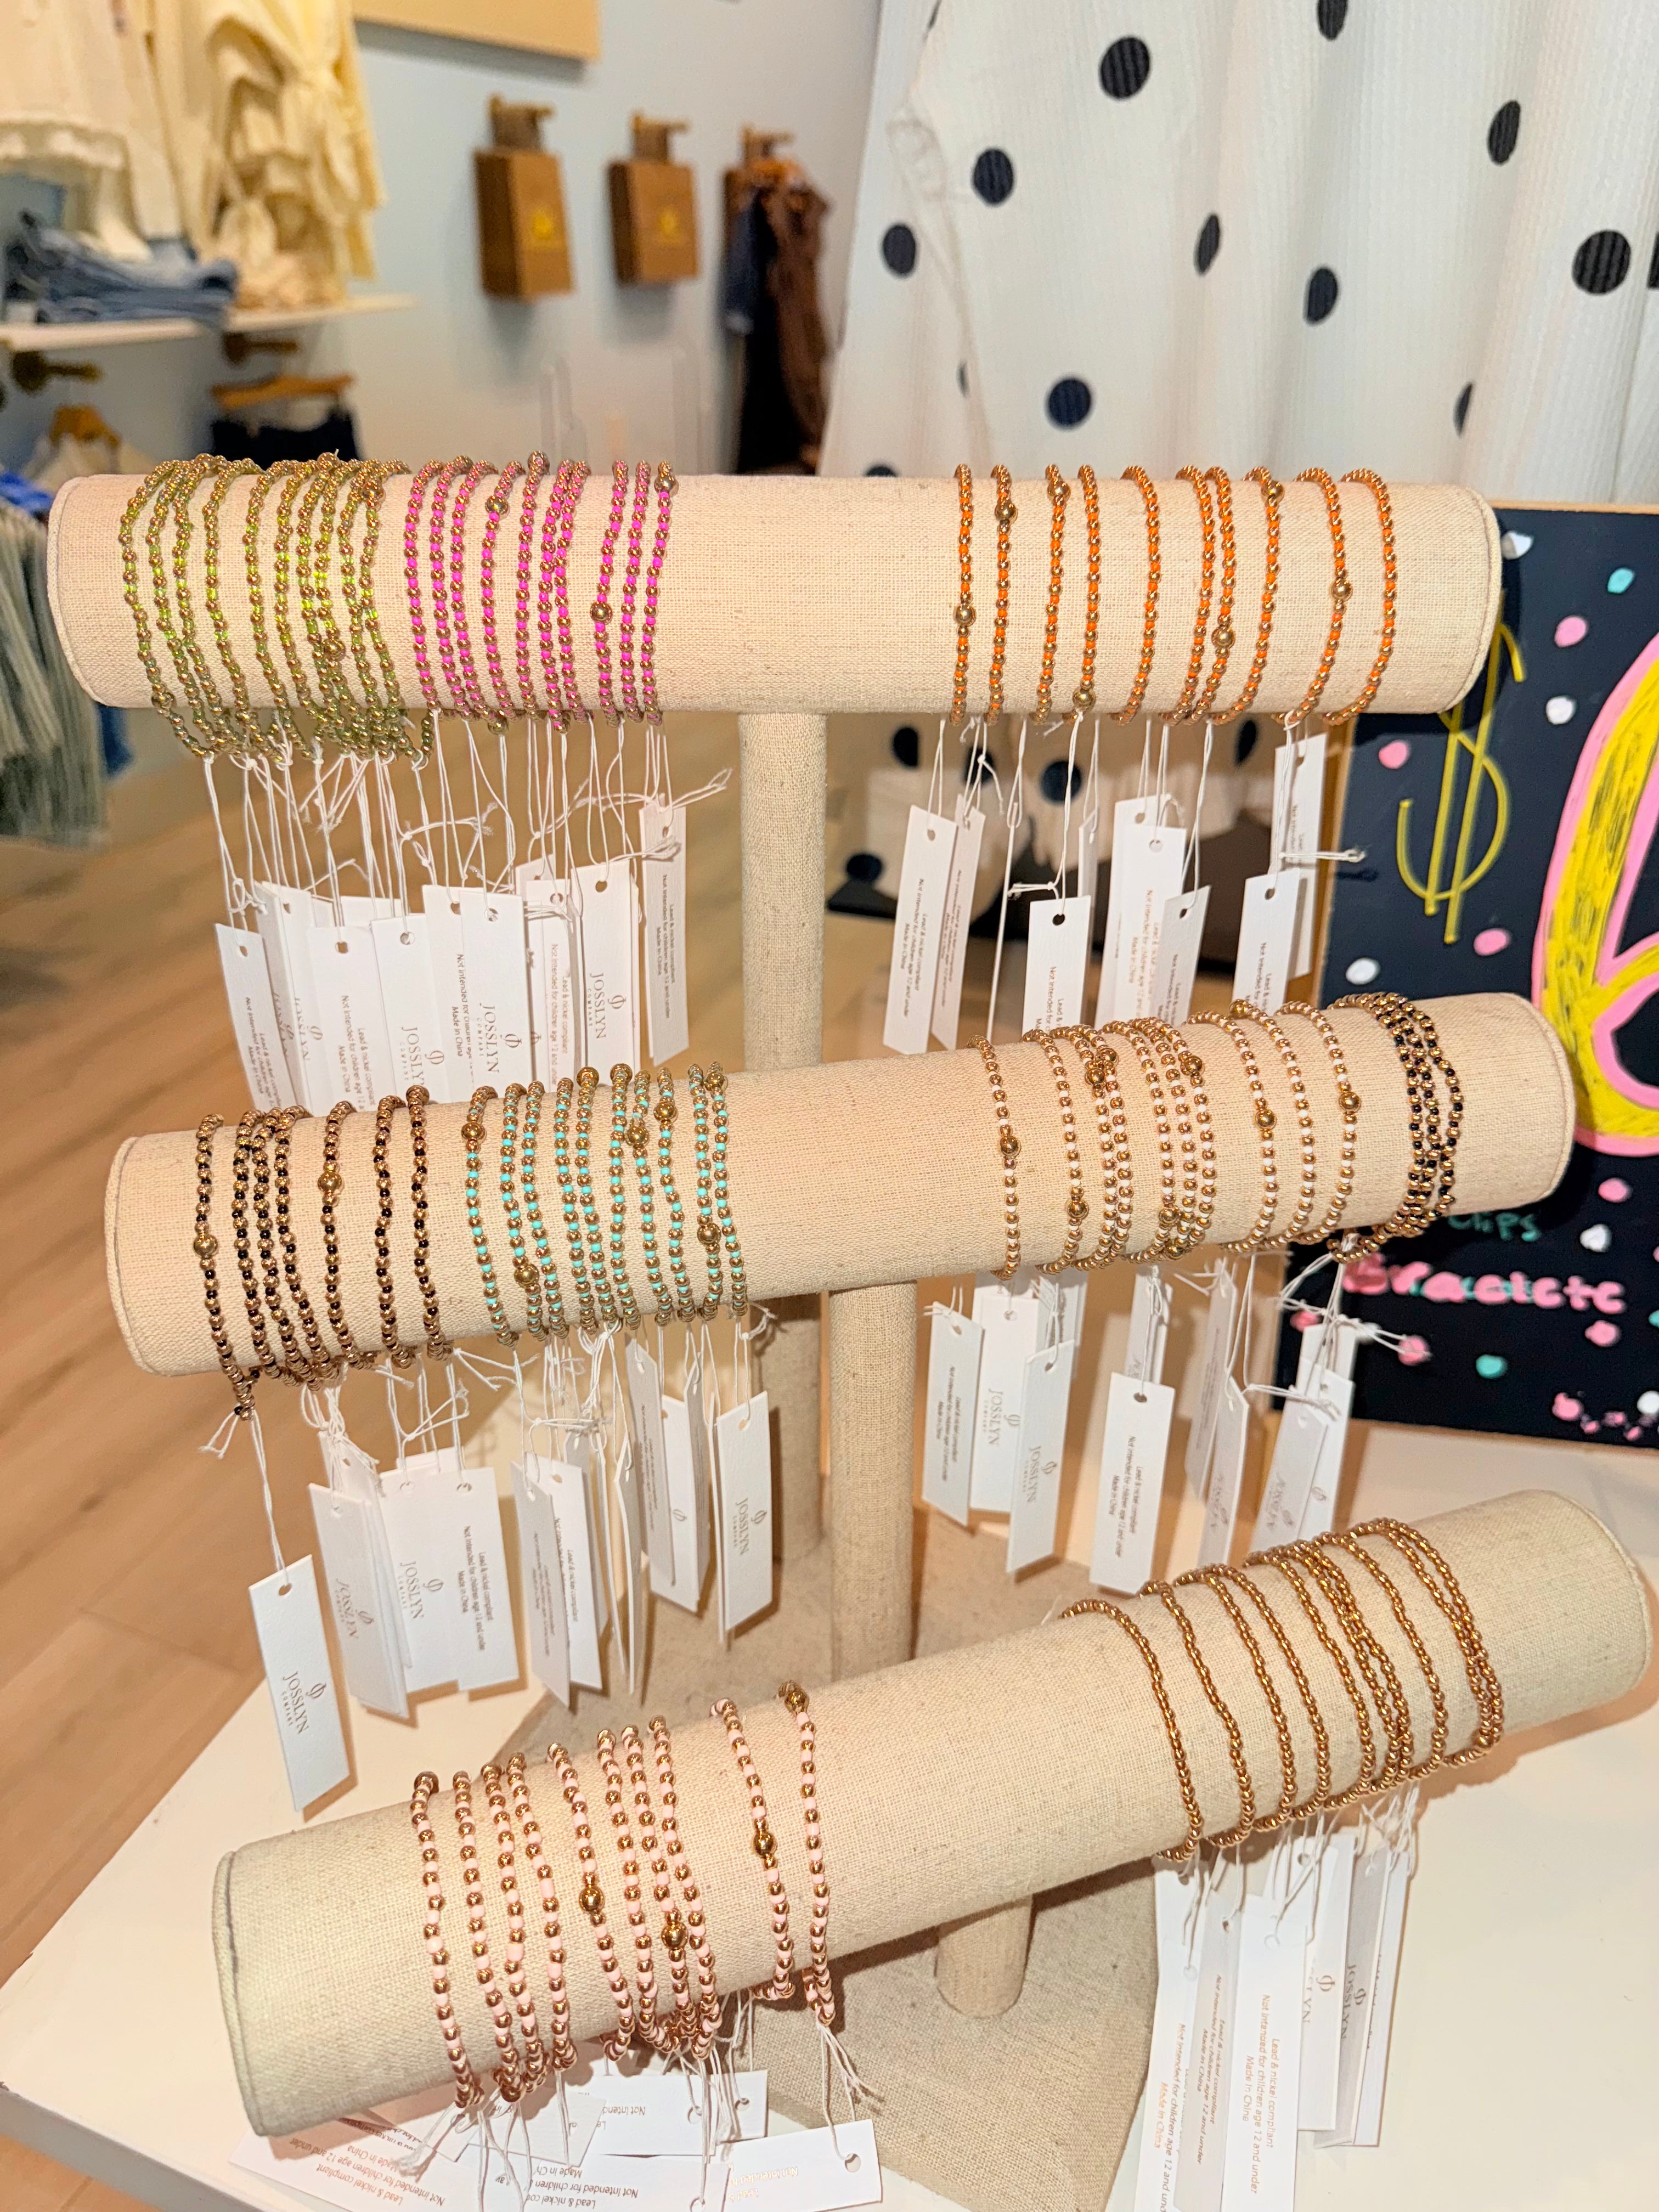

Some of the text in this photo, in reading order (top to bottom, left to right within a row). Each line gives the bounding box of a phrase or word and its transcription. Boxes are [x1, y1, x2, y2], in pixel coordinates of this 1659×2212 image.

[458, 970, 467, 1002] intended
[452, 1006, 460, 1026] Made
[590, 972, 607, 1039] JOSSLYN
[482, 1005, 499, 1073] JOSSLYN
[402, 1026, 425, 1085] JOSSLY
[988, 1388, 1003, 1446] JOSSLYN
[1026, 1445, 1042, 1503] JOSSLYN
[736, 1497, 750, 1556] JOSSLYN
[399, 1561, 425, 1620] JOSSLYN
[336, 1578, 359, 1639] JOSSLYN
[281, 1671, 309, 1734] JOSSLYN
[1211, 1992, 1220, 2031] intended
[1177, 2023, 1186, 2040] Not
[1173, 2042, 1184, 2083] intended
[1271, 2038, 1280, 2060] Lead
[1172, 2084, 1180, 2097] for
[1243, 2055, 1254, 2121] Made in China
[1251, 1994, 1270, 2194] Not intended for children age 12 and under
[1269, 2071, 1278, 2098] nickel
[630, 2106, 646, 2115] Not
[1154, 2081, 1168, 2148] Made in China
[1169, 2098, 1178, 2136] children
[1203, 2103, 1209, 2115] 12
[1266, 2100, 1276, 2148] compliant
[347, 2145, 370, 2160] China
[369, 2152, 379, 2162] in
[1165, 2137, 1173, 2156] age
[289, 2137, 446, 2207] Not intended for children age 12 and under
[316, 2164, 354, 2183] compliant
[549, 2166, 558, 2174] in
[1164, 2159, 1172, 2171] 12
[354, 2181, 377, 2193] nickel
[383, 2191, 404, 2205] Lead
[535, 2180, 639, 2198] Not intended for children
[541, 2195, 566, 2206] nickel
[568, 2198, 575, 2207] &
[576, 2198, 597, 2209] Lead
